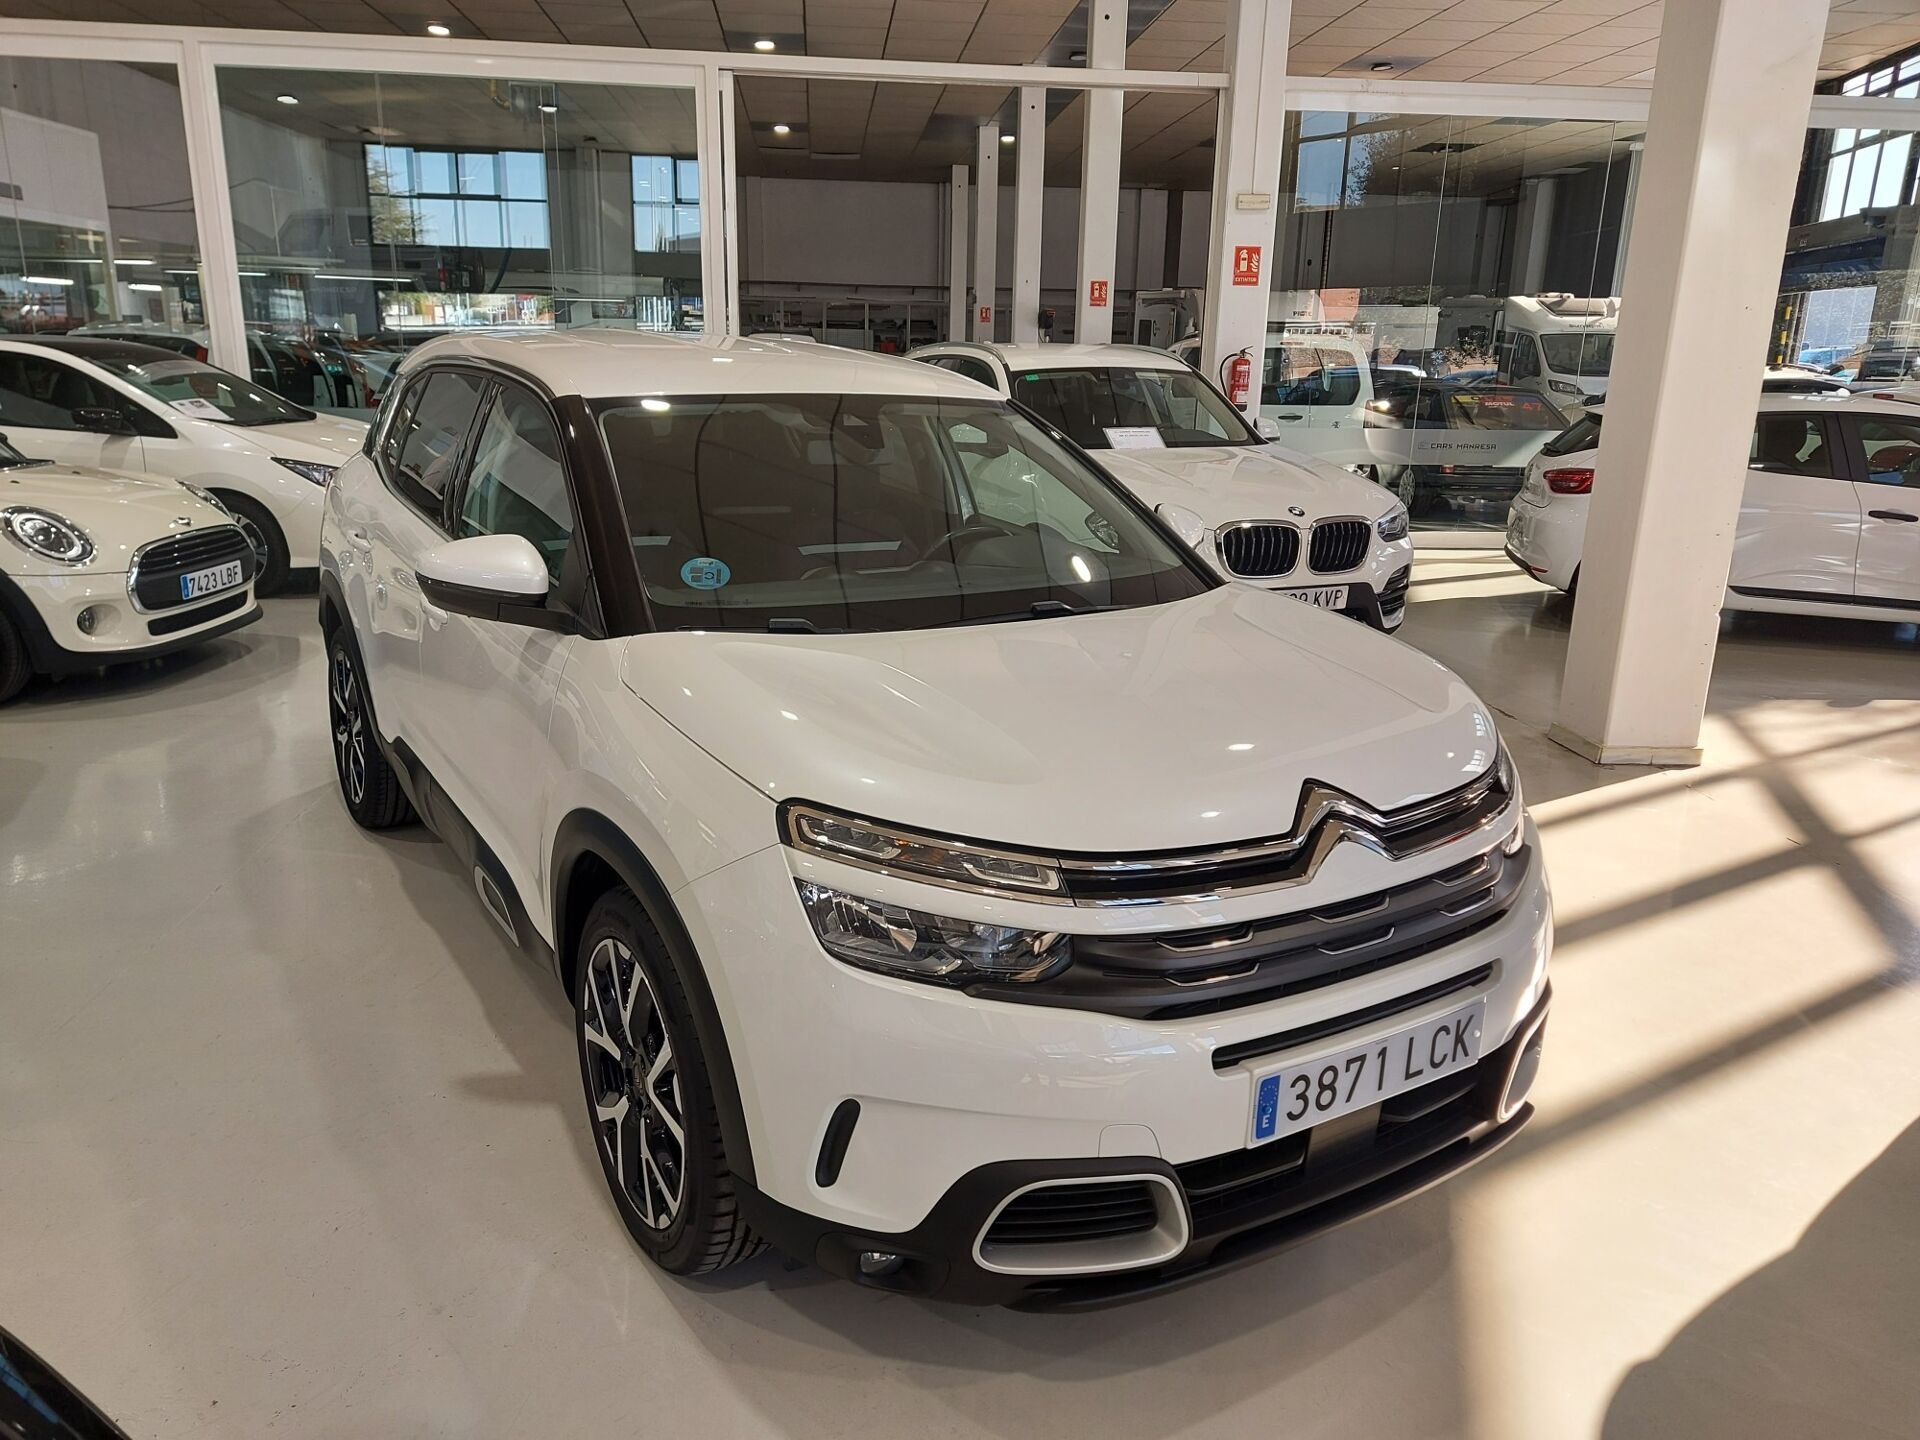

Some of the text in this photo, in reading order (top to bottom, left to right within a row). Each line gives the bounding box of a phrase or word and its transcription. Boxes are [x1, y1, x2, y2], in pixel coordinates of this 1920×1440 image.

[1456, 442, 1497, 451] MANRESA
[189, 564, 239, 596] 7423 LBF
[1313, 589, 1344, 607] KVP
[1286, 1014, 1475, 1122] 3871 LCK
[1261, 1114, 1270, 1129] E
